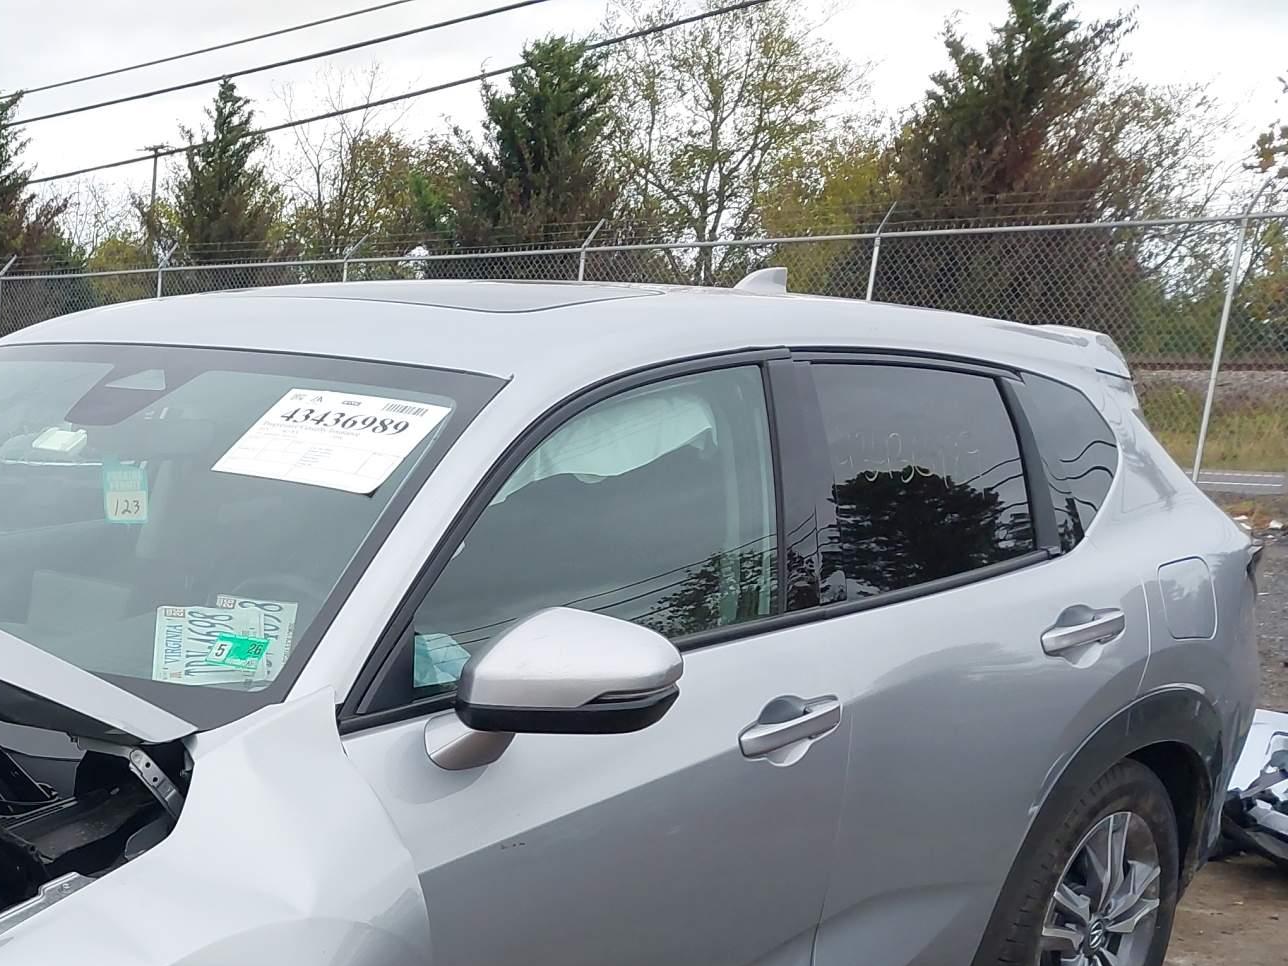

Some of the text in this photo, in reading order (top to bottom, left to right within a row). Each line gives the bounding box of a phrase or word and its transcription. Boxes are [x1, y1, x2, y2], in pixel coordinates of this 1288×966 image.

[280, 407, 410, 436] 43436989
[114, 498, 140, 517] 123
[164, 624, 183, 665] VIRGINIA
[214, 643, 228, 657] 5
